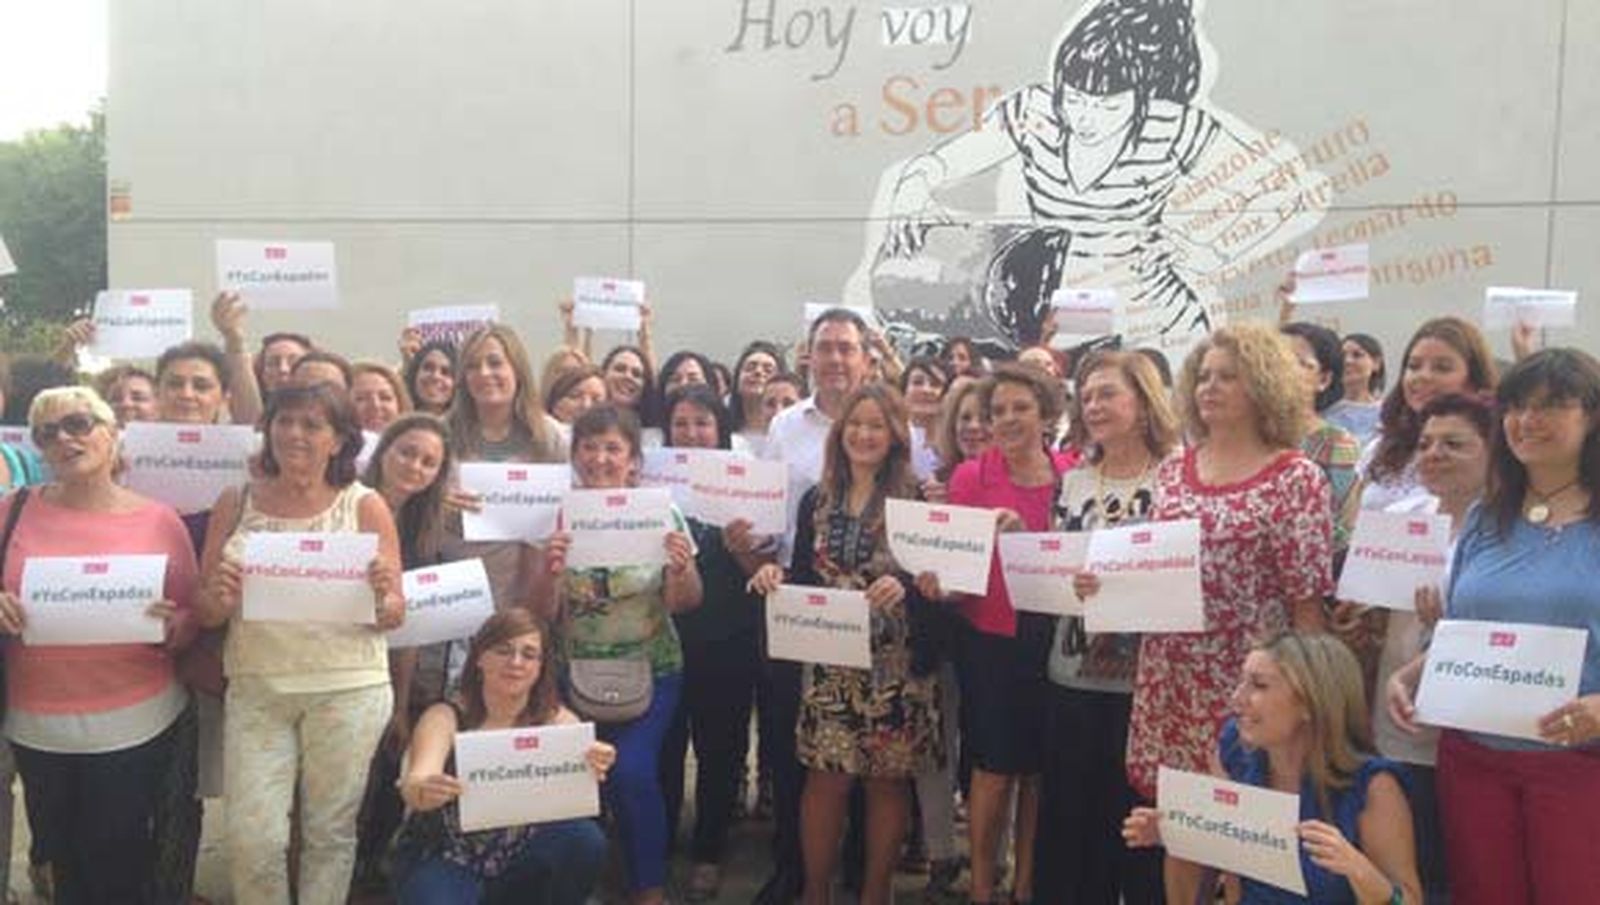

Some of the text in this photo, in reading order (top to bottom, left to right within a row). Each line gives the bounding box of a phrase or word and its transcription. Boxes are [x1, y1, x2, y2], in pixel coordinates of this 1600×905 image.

[723, 0, 973, 81] Hoy voy
[831, 102, 861, 137] a
[1434, 659, 1567, 689] #YoConEspadas
[1168, 808, 1289, 852] #YoConEspadas
